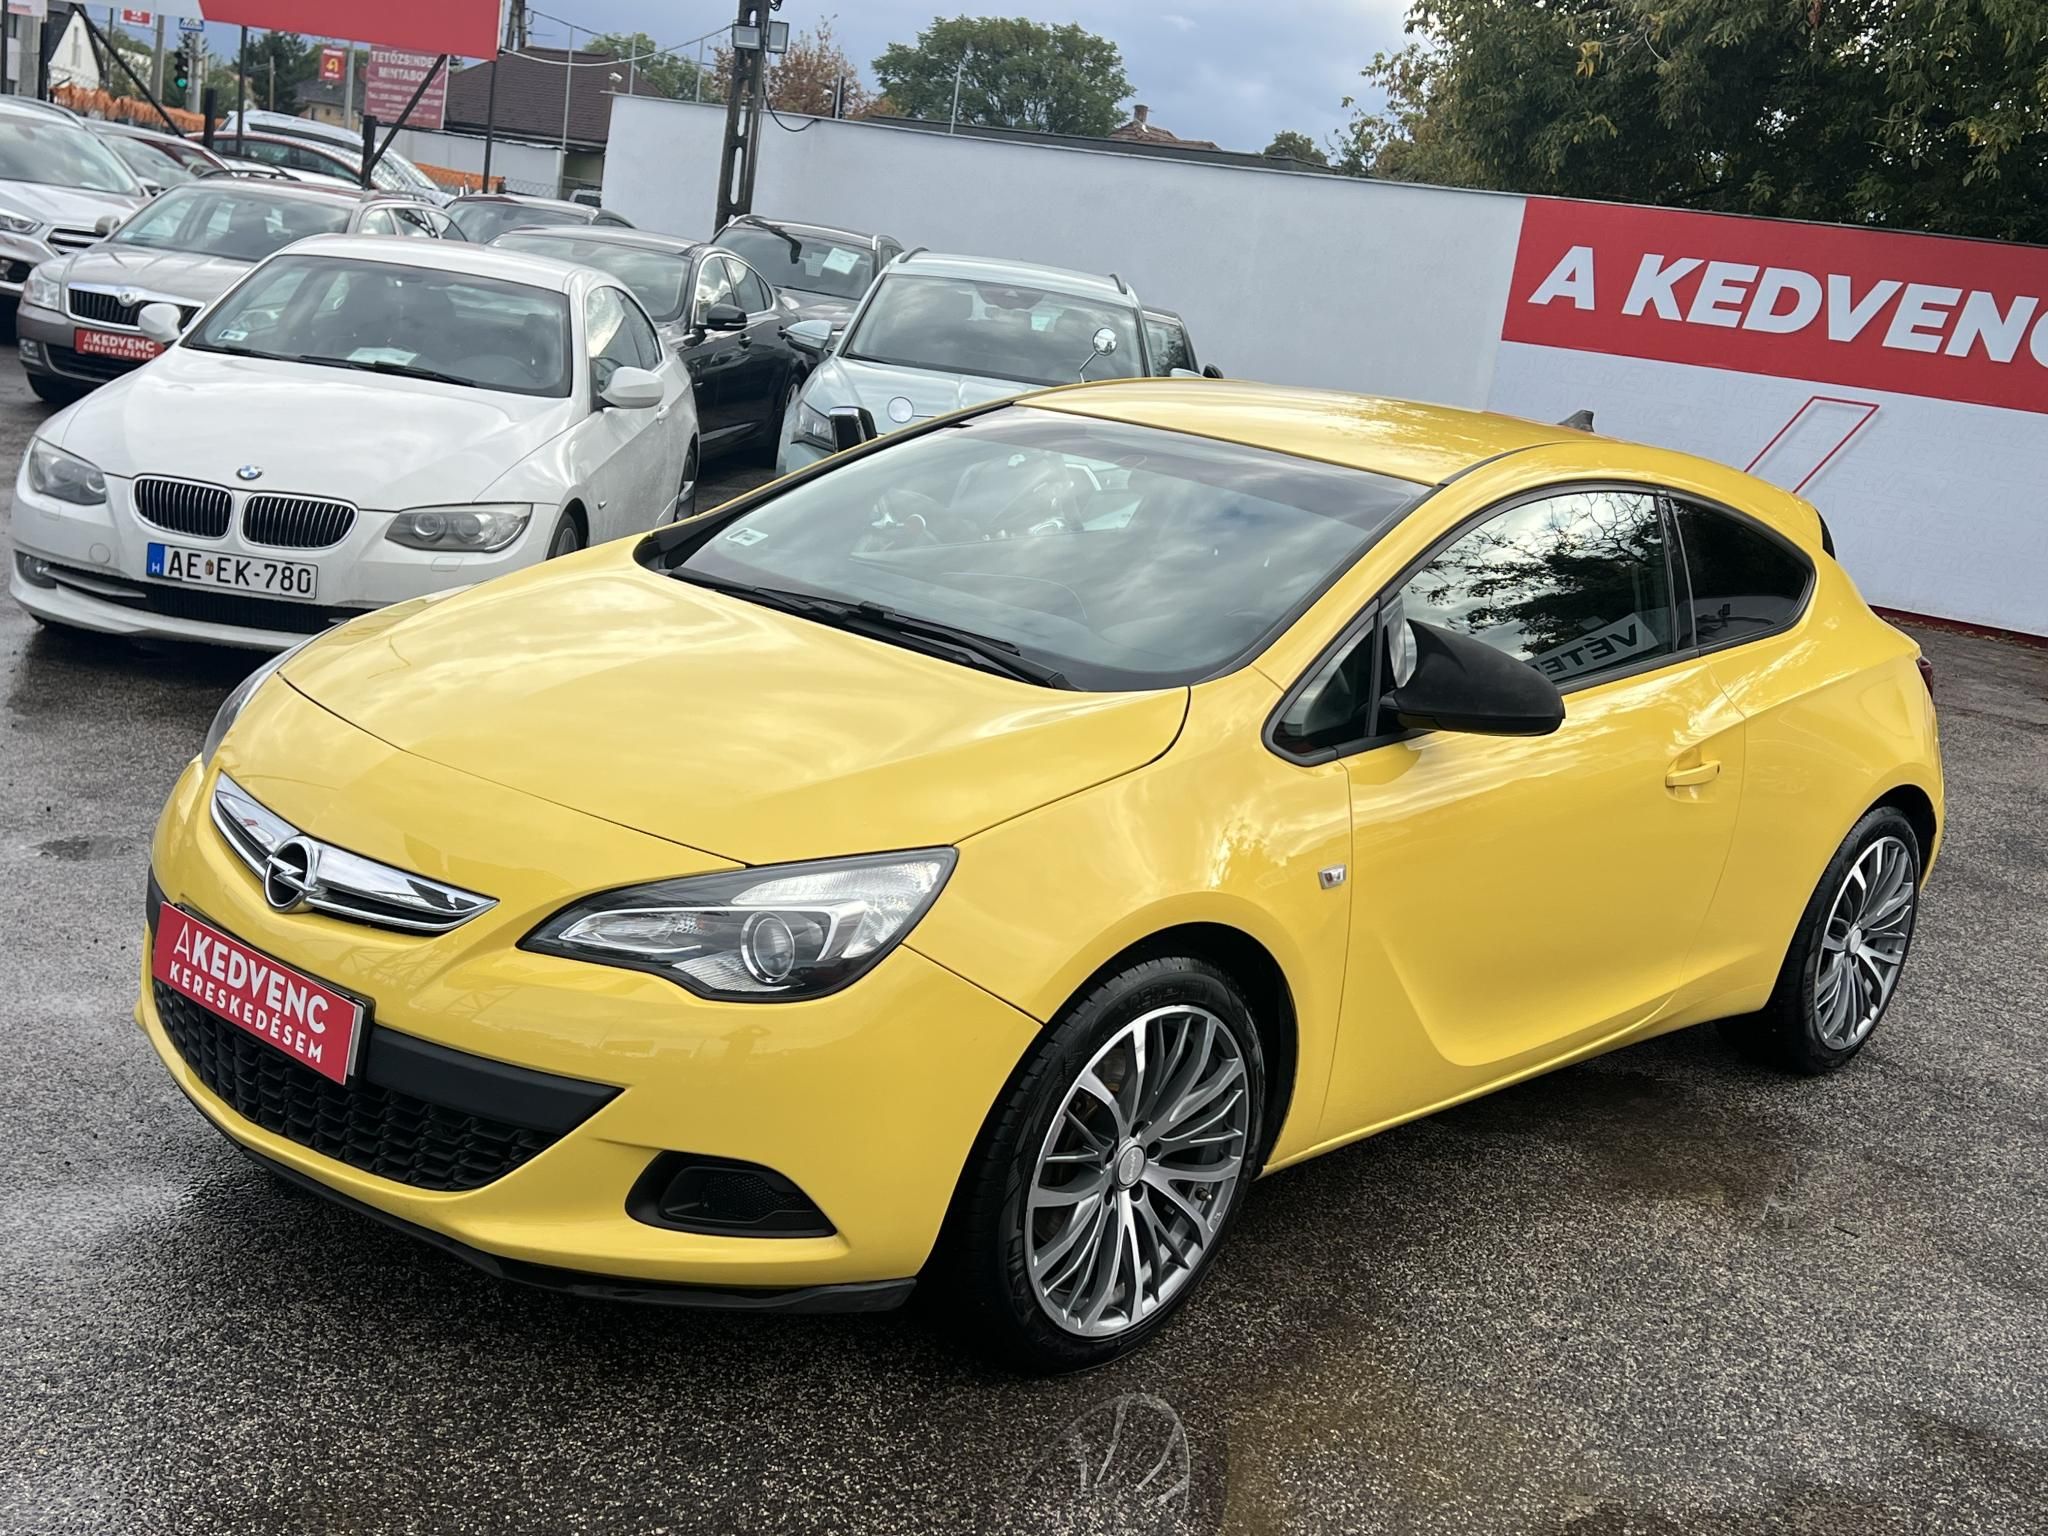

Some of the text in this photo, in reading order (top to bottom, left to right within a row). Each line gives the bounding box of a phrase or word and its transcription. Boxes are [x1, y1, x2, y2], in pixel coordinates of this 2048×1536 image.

[1527, 245, 2048, 369] A KEDVEN
[151, 562, 160, 573] H
[168, 550, 312, 594] AE EK-780
[169, 960, 323, 1064] KERESKEDÉSEM
